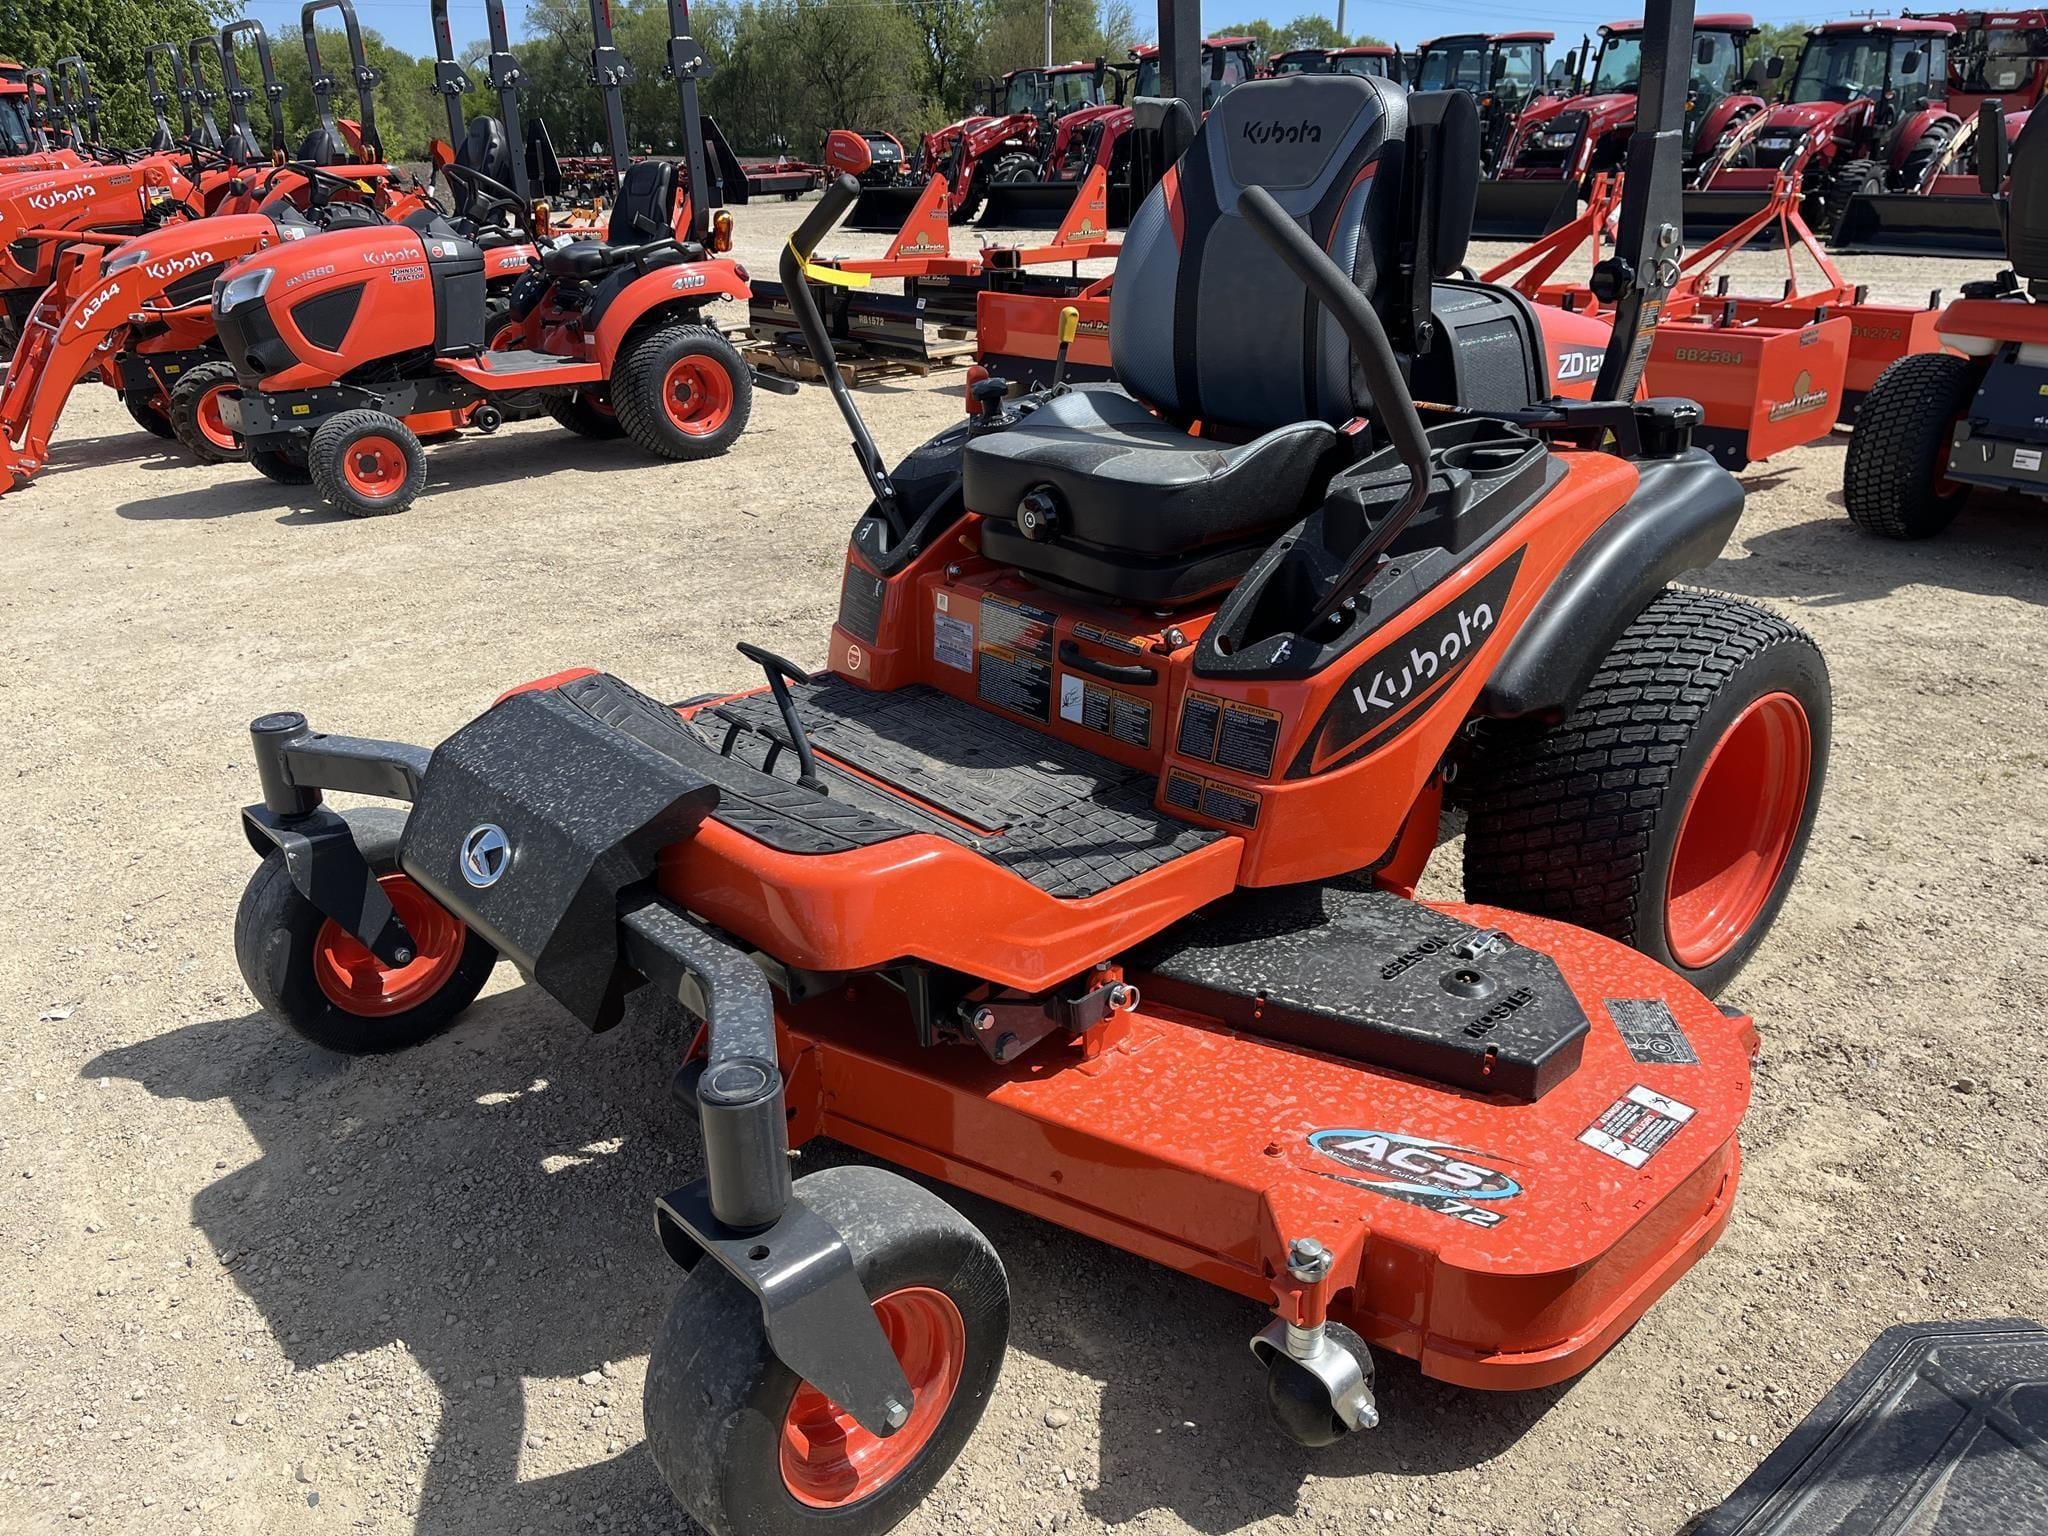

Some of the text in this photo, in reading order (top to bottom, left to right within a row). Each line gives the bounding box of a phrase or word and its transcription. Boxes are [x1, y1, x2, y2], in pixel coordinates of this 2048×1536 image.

[1243, 120, 1321, 144] Kubota
[28, 184, 96, 209] Kubota
[146, 251, 214, 279] Kubota
[363, 247, 420, 265] Kubota
[390, 266, 423, 276] JOHNSON
[392, 273, 425, 282] TRACTOR
[673, 275, 705, 290] 4WD
[75, 283, 120, 330] LA344
[858, 314, 885, 327] RB1572
[1675, 348, 1743, 364] BB2584
[1352, 603, 1493, 714] Kubota
[1334, 1135, 1495, 1188] ACS
[1390, 1168, 1430, 1186] Cutting
[1431, 1181, 1472, 1198] System
[1438, 1199, 1501, 1227] 72
